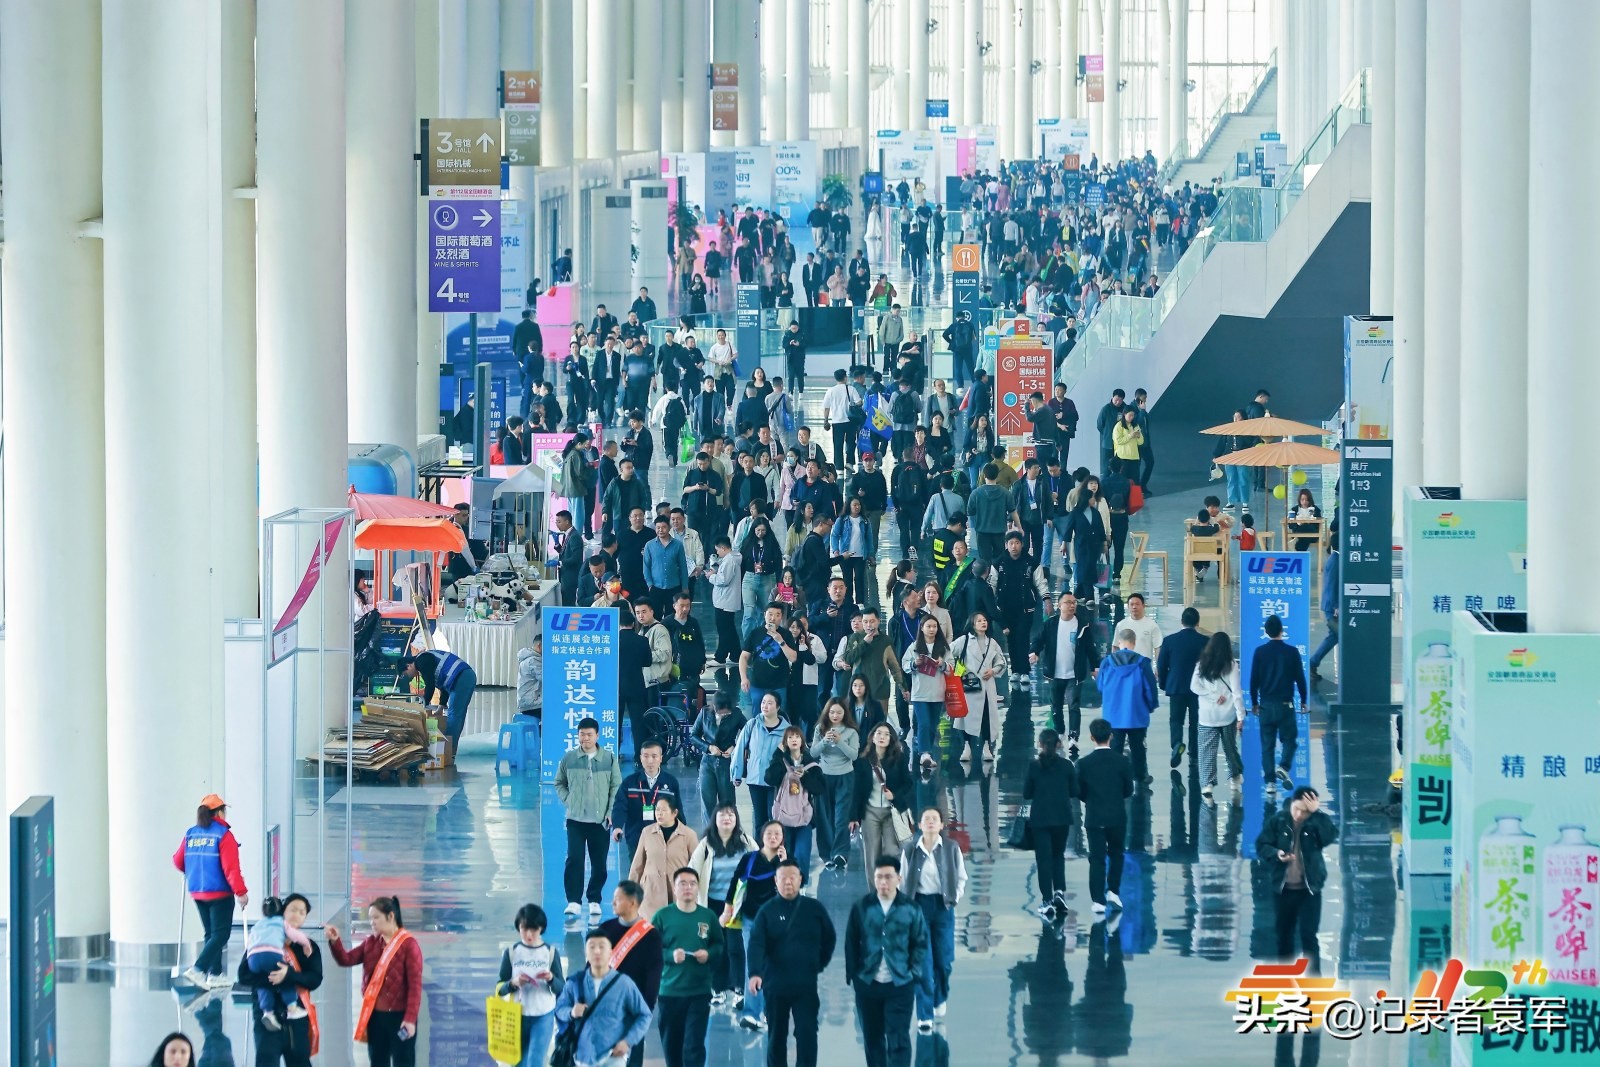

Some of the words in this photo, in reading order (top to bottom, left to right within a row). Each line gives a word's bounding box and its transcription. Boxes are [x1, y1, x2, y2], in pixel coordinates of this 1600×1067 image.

[436, 159, 472, 168] 国际机械
[435, 235, 493, 247] 国际葡萄酒
[435, 248, 470, 260] 及烈酒
[1019, 368, 1046, 376] 国际机械
[1350, 462, 1369, 471] 展厅
[1350, 499, 1367, 507] 入口
[1350, 516, 1358, 527] B
[1248, 576, 1303, 585] 纵连展会物流
[1248, 587, 1303, 595] 指定快递合作商
[1349, 599, 1368, 608] 展厅
[1348, 616, 1357, 628] 4
[551, 633, 611, 643] 纵连展会物流
[551, 645, 611, 655] 指定快递合作商
[1483, 876, 1530, 956] 茶啤
[1548, 886, 1593, 963] 茶啤
[1548, 968, 1597, 981] KAISER
